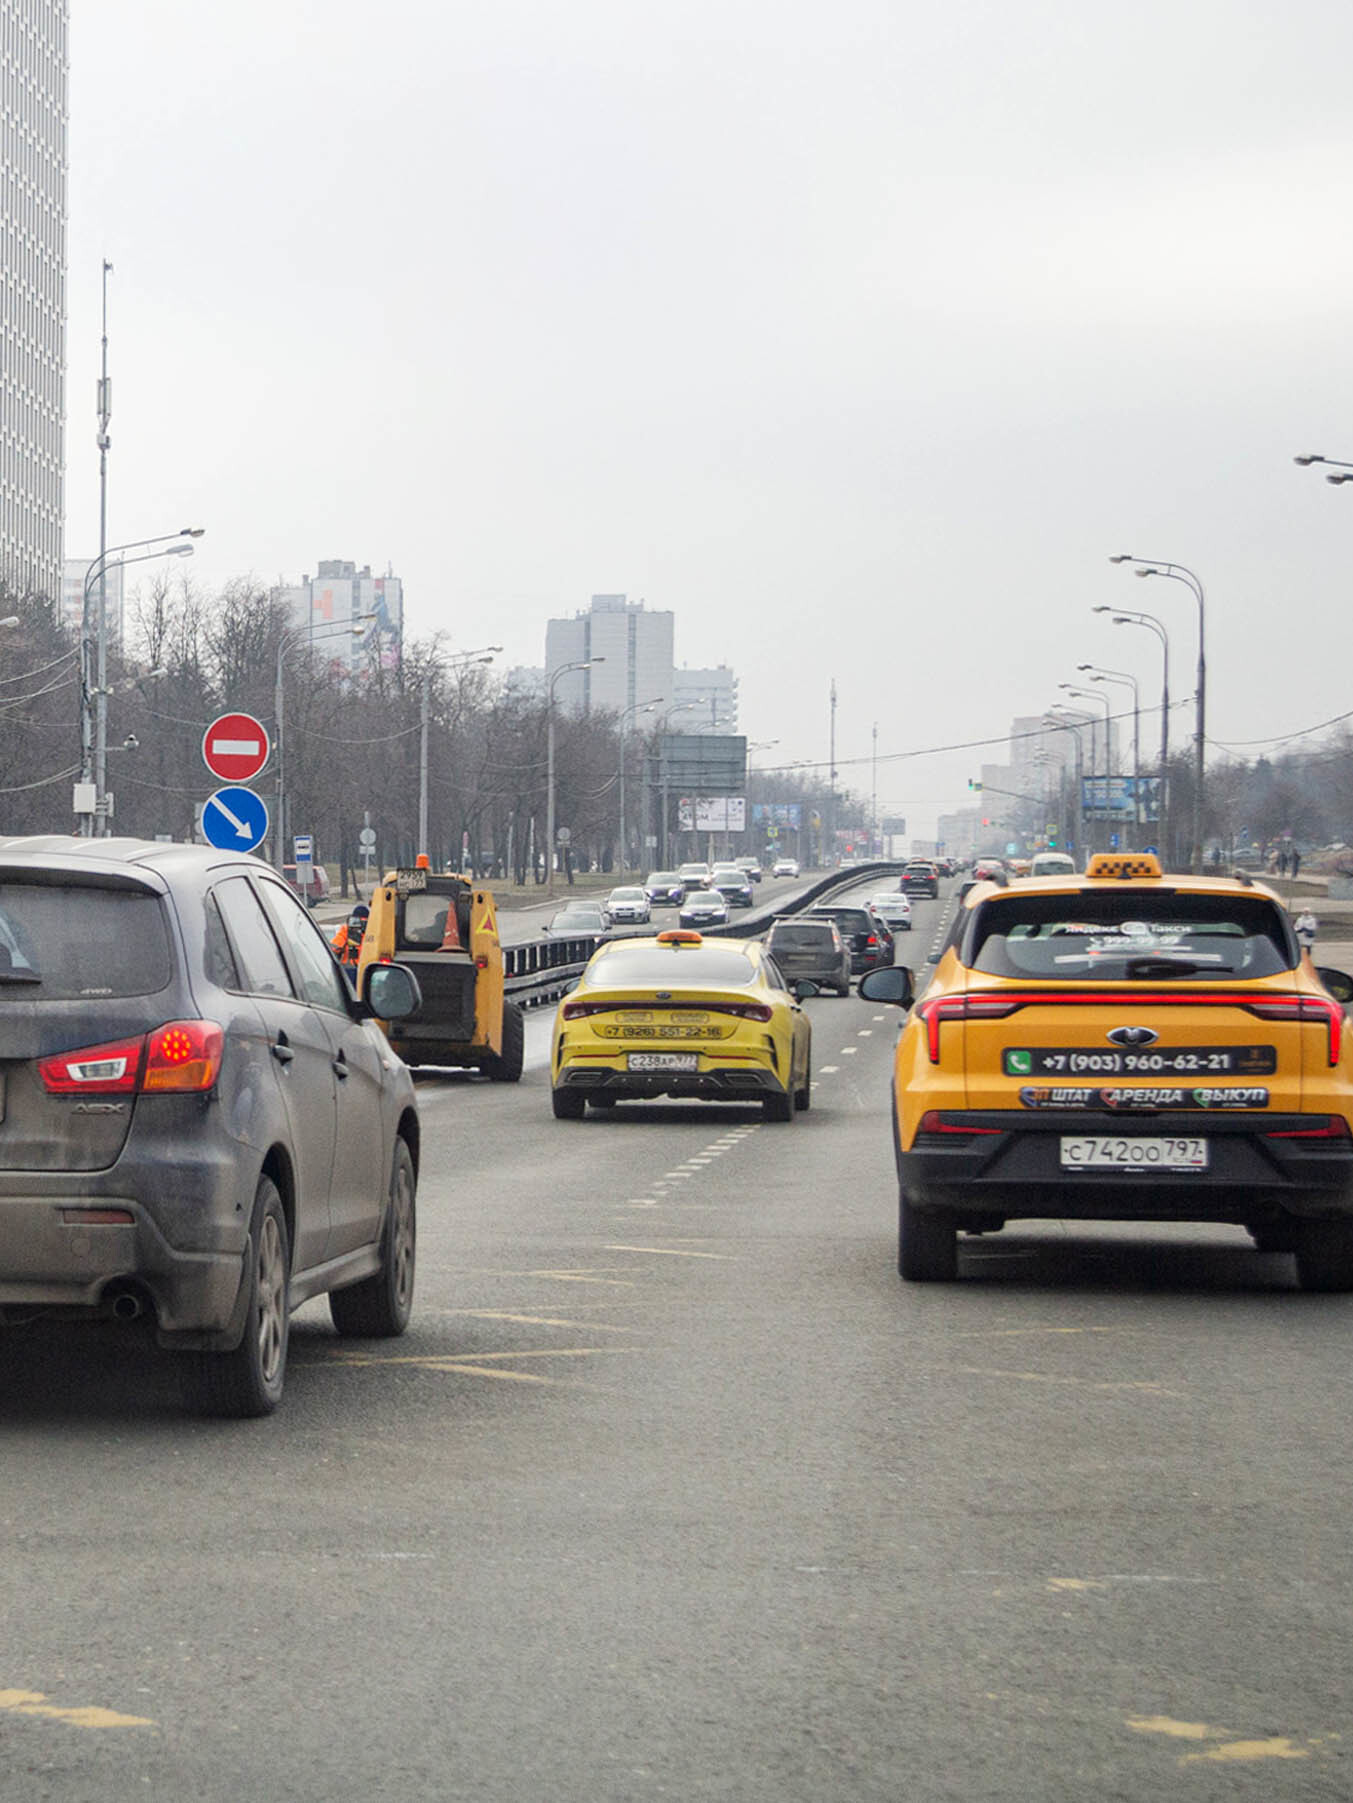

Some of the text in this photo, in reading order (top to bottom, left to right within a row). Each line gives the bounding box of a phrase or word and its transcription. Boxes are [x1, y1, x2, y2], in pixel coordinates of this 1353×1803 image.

[1042, 1055, 1066, 1070] +7
[1069, 1054, 1120, 1072] (903)
[1125, 1053, 1231, 1070] 960-62-21
[1051, 1088, 1092, 1101] ШТАТ
[1109, 1088, 1183, 1103] АРЕНДА
[1200, 1087, 1266, 1101] ВЫКУП
[73, 1103, 126, 1114] ASX
